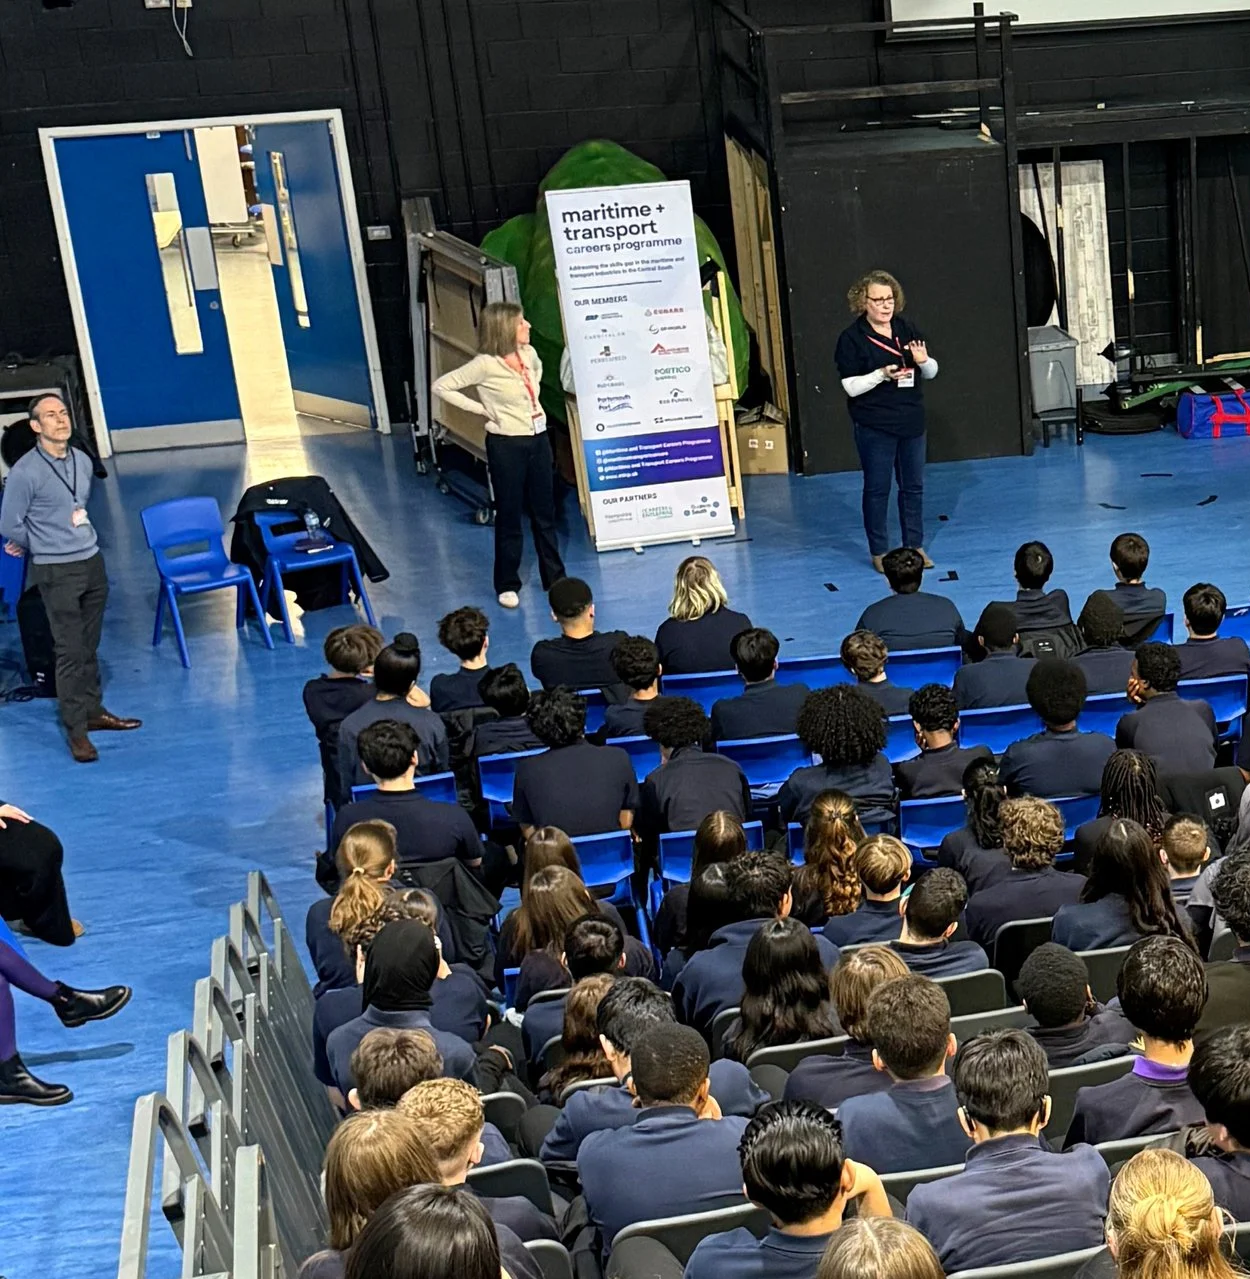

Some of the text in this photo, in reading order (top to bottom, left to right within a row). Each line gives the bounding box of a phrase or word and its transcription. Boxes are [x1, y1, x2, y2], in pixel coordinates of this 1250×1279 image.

[562, 202, 651, 223] maritime
[563, 220, 658, 240] transport
[566, 237, 682, 254] careers programme
[574, 295, 628, 307] OUR MEMBERS
[654, 366, 691, 375] PORTICO
[620, 493, 657, 502] PARTNERS
